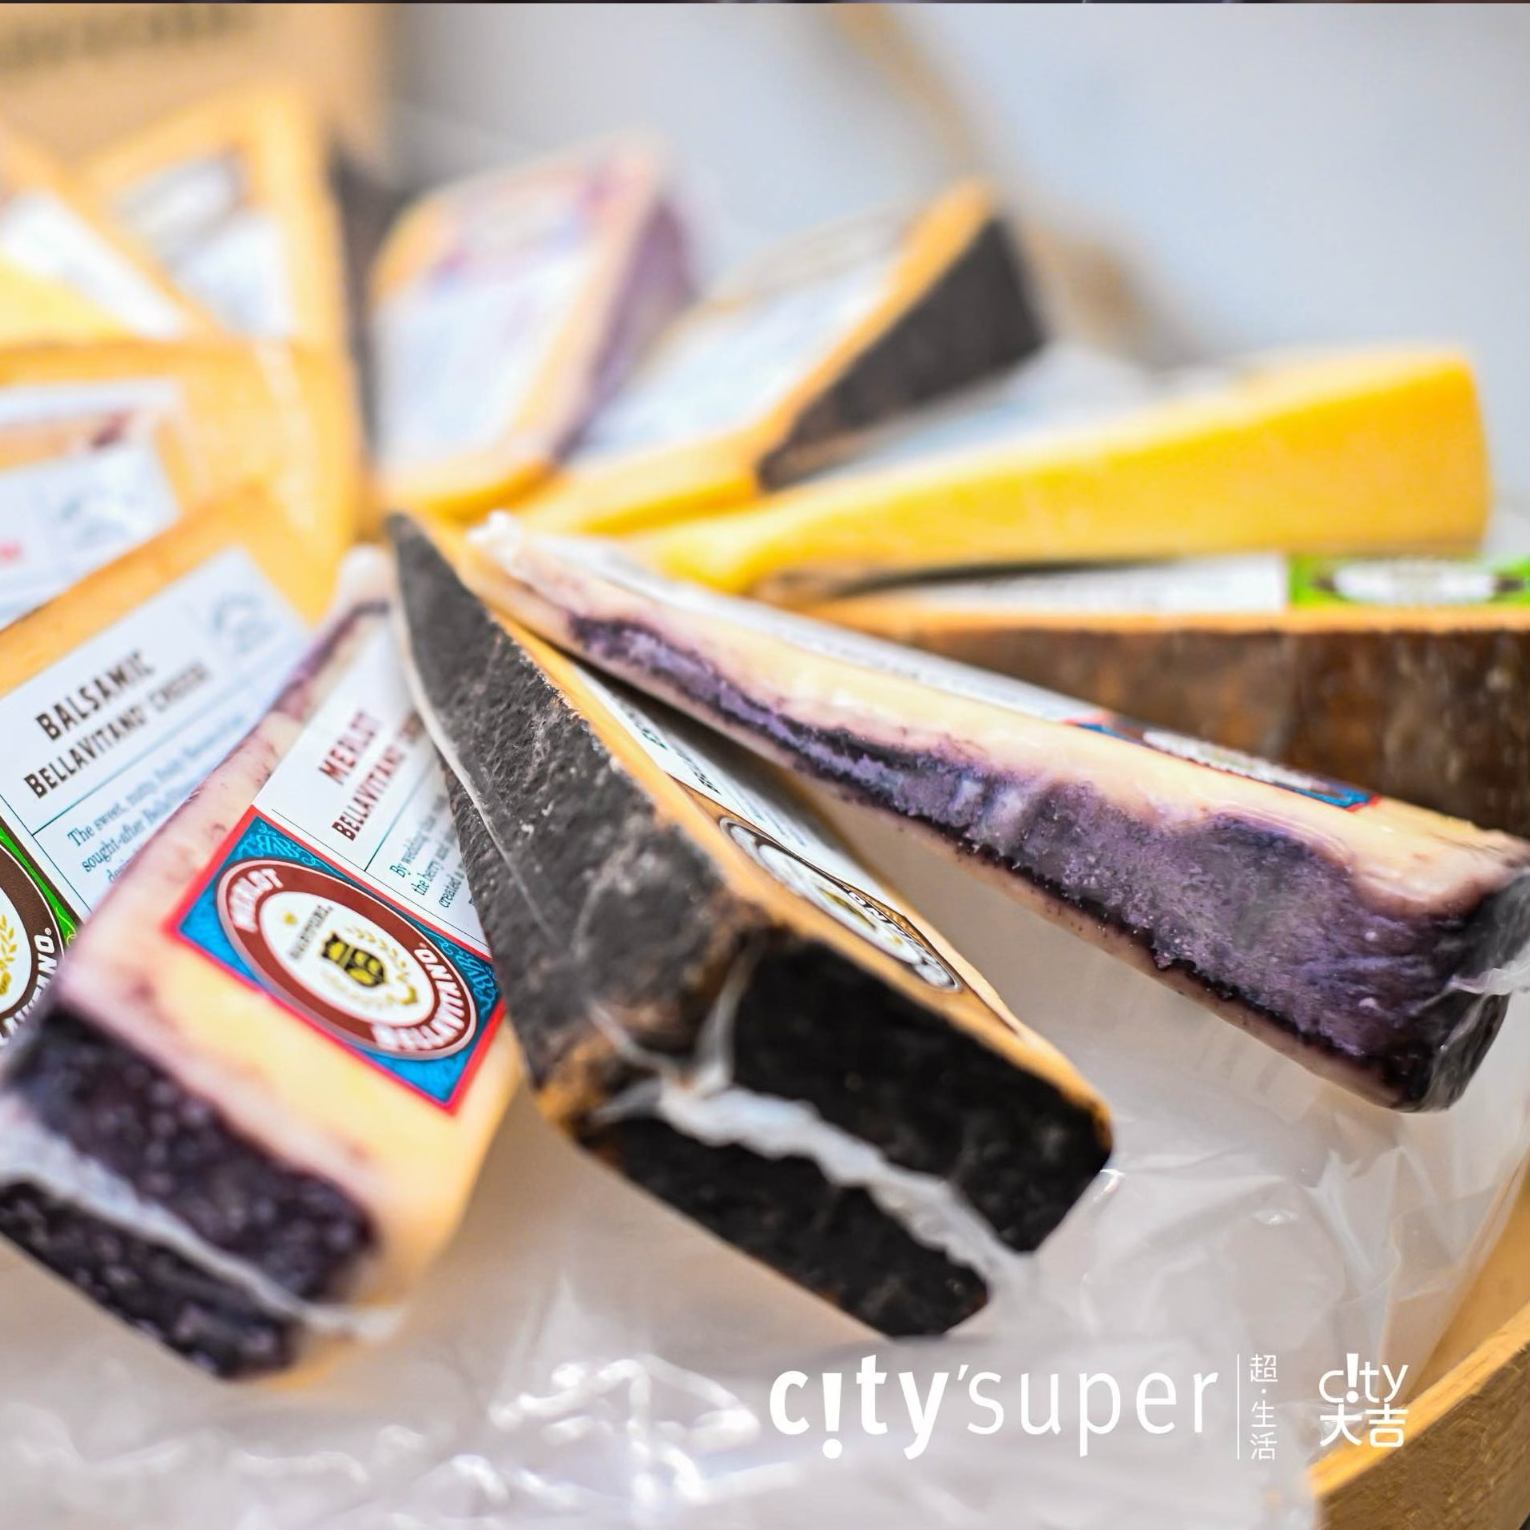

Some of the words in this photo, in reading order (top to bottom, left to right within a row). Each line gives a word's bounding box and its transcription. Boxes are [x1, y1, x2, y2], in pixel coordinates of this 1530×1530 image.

[35, 650, 154, 742] BALSAMIC
[67, 823, 96, 849] The
[390, 863, 407, 879] By
[411, 876, 430, 896] the
